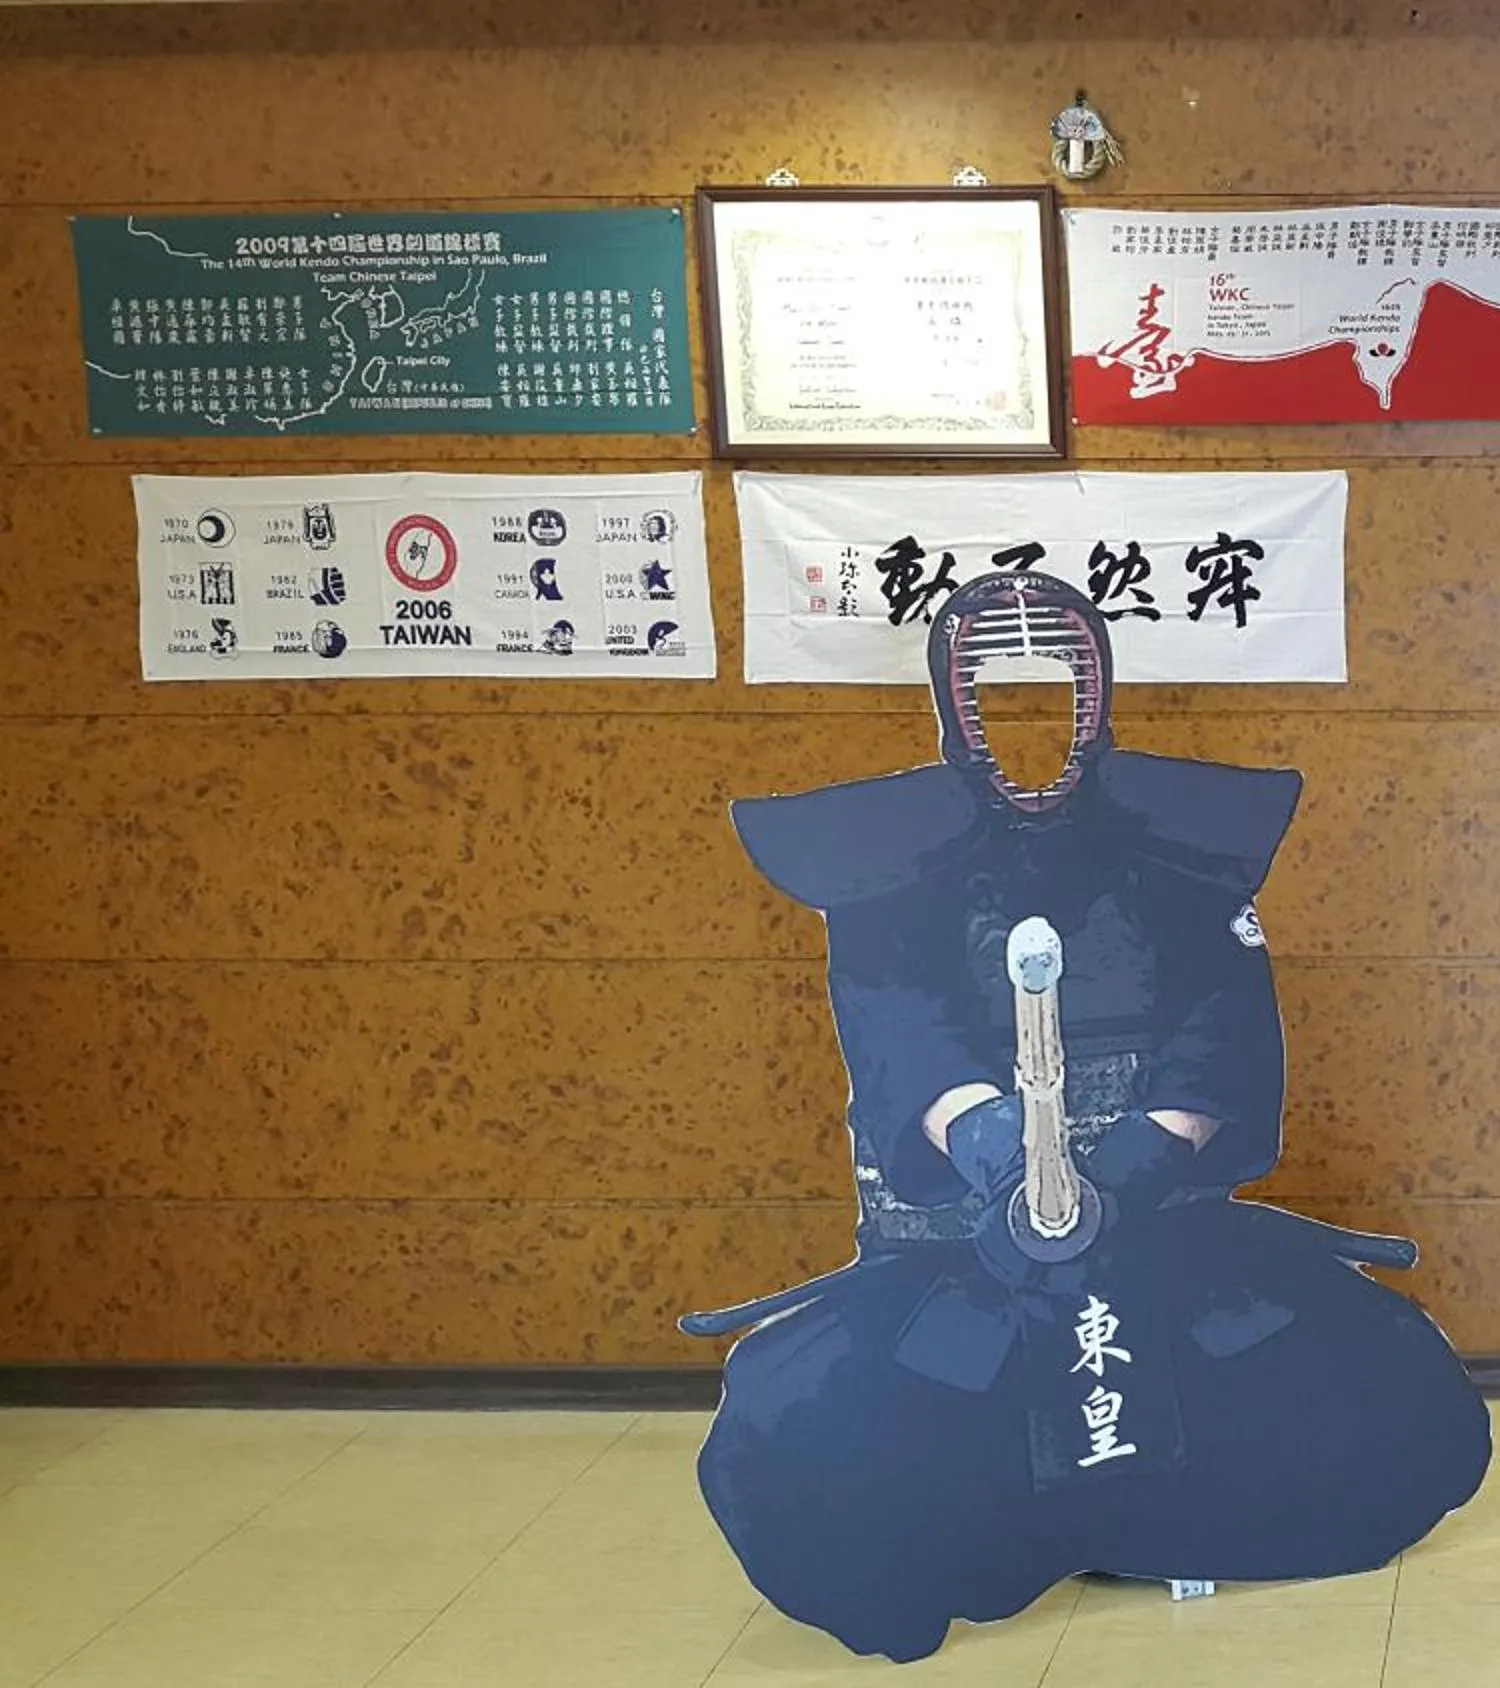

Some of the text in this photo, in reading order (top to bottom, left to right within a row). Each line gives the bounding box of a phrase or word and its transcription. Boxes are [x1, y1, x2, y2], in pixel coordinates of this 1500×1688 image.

[200, 259, 224, 270] The
[228, 257, 256, 269] 14th
[259, 257, 297, 269] World
[299, 257, 339, 268] Kendo
[342, 254, 429, 268] Championship
[512, 253, 547, 265] Brazil
[313, 271, 436, 283] Team Chinese Taipei
[1209, 287, 1251, 301] WKC
[430, 355, 451, 367] City
[160, 533, 196, 544] JAPAN
[263, 535, 301, 545] JAPAN
[493, 532, 527, 543] KOREA
[595, 533, 638, 543] JAPAN
[265, 588, 305, 599] BRAZIL
[395, 600, 452, 620] 2006
[379, 624, 472, 646] TAIWAN
[272, 645, 311, 653] FRANCE
[495, 643, 534, 653] FRANCE
[1068, 1294, 1137, 1468] 東皇
